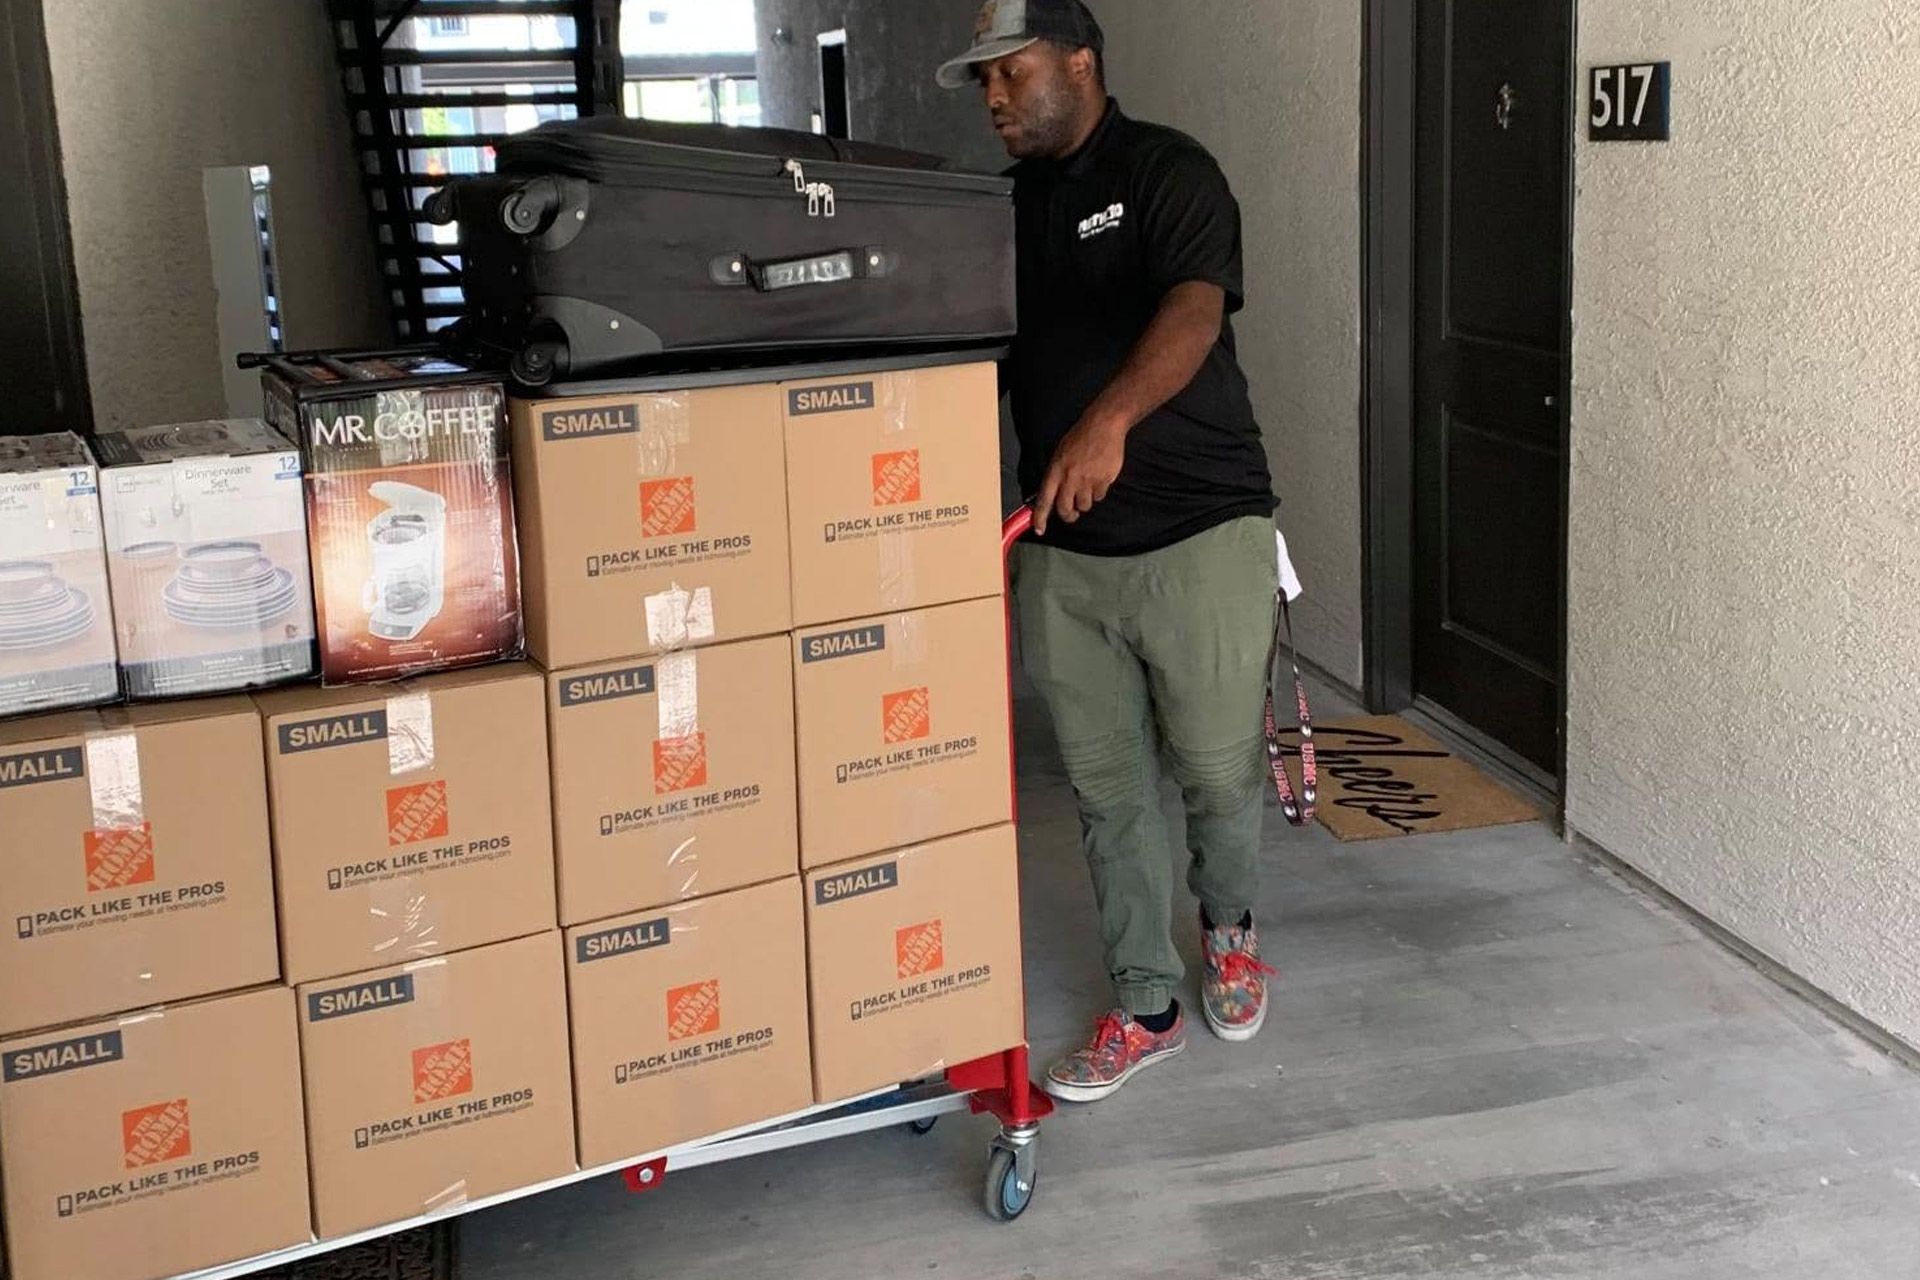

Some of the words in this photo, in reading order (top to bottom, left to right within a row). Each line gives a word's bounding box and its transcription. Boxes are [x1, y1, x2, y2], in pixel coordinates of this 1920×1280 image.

[1592, 65, 1654, 127] 517
[797, 388, 867, 410] SMALL
[315, 414, 372, 446] MR.
[374, 405, 495, 440] COFFEE
[552, 410, 631, 434] SMALL
[69, 471, 89, 487] 12
[185, 465, 252, 481] Dinnerware
[278, 456, 298, 471] 12
[838, 518, 872, 532] PACK
[877, 514, 904, 526] LIKE
[908, 510, 932, 522] THE
[936, 505, 968, 518] PROS
[602, 550, 640, 565] PACK
[646, 545, 677, 560] LIKE
[682, 541, 709, 554] THE
[714, 535, 751, 549] PROS
[810, 631, 877, 657] SMALL
[569, 673, 646, 700] SMALL
[289, 716, 378, 747] SMALL
[0, 755, 72, 781] MALL
[850, 757, 882, 772] PACK
[887, 749, 913, 764] LIKE
[918, 744, 941, 757] THE
[945, 737, 976, 752] PROS
[1301, 742, 1317, 786] USMC
[1272, 759, 1294, 801] USMC
[390, 781, 446, 844] HOME
[615, 807, 652, 823] PACK
[658, 800, 688, 814] LIKE
[693, 793, 719, 807] THE
[724, 785, 759, 801] PROS
[88, 828, 151, 890] HOME
[344, 859, 387, 877] PACK
[393, 852, 428, 868] LIKE
[433, 845, 463, 860] THE
[468, 836, 510, 853] PROS
[823, 869, 890, 898] SMALL
[36, 906, 85, 925] PACK
[92, 899, 132, 915] LIKE
[138, 891, 171, 907] THE
[178, 882, 225, 899] PROS
[586, 926, 661, 956] SMALL
[319, 982, 404, 1014] SMALL
[864, 992, 896, 1008] PACK
[901, 983, 927, 998] LIKE
[931, 975, 955, 989] THE
[959, 965, 990, 982] PROS
[669, 981, 719, 1038] HOME
[14, 1039, 112, 1074] SMALL
[630, 1054, 666, 1072] PACK
[671, 1046, 702, 1061] LIKE
[706, 1038, 732, 1053] THE
[737, 1027, 773, 1045] PROS
[371, 1117, 413, 1136] PACK
[419, 1108, 453, 1125] LIKE
[458, 1099, 488, 1115] THE
[492, 1088, 533, 1107] PROS
[76, 1183, 124, 1204] PACK
[129, 1173, 168, 1191] LIKE
[174, 1164, 208, 1182] THE
[213, 1151, 259, 1172] PROS
